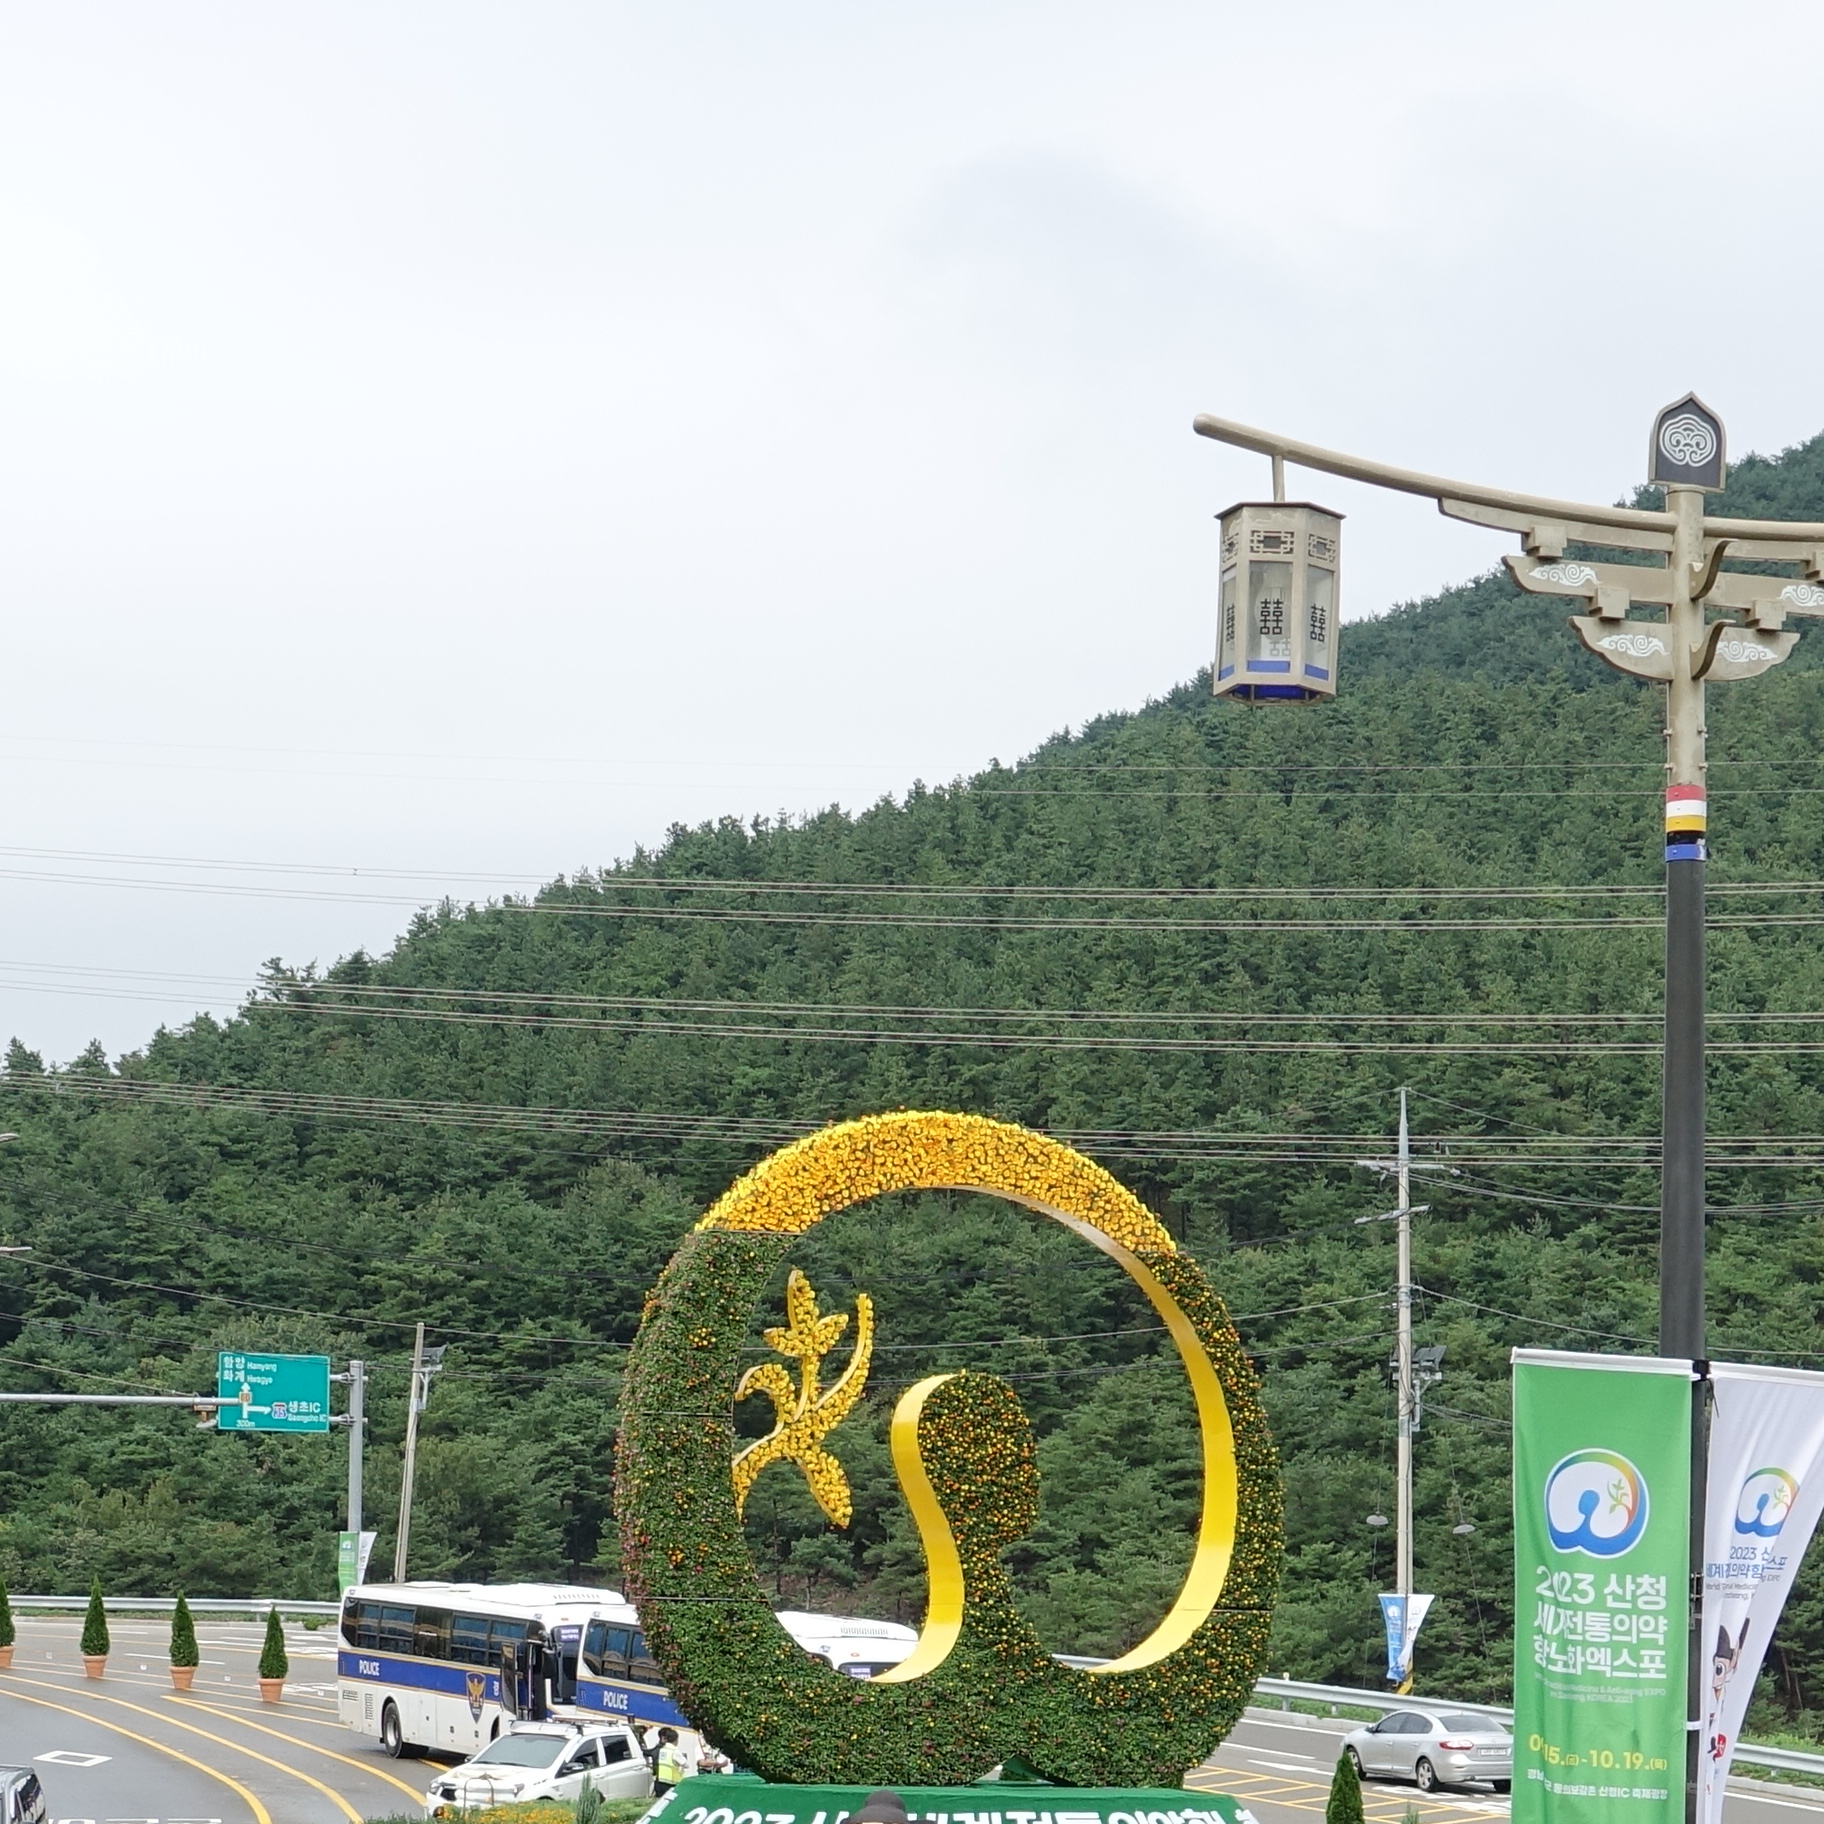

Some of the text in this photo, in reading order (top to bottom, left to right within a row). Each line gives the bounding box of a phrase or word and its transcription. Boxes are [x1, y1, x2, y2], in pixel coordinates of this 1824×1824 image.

[1604, 1573, 1667, 1610] 산청
[359, 1659, 380, 1676] POLICE
[603, 1690, 628, 1710] POLICE
